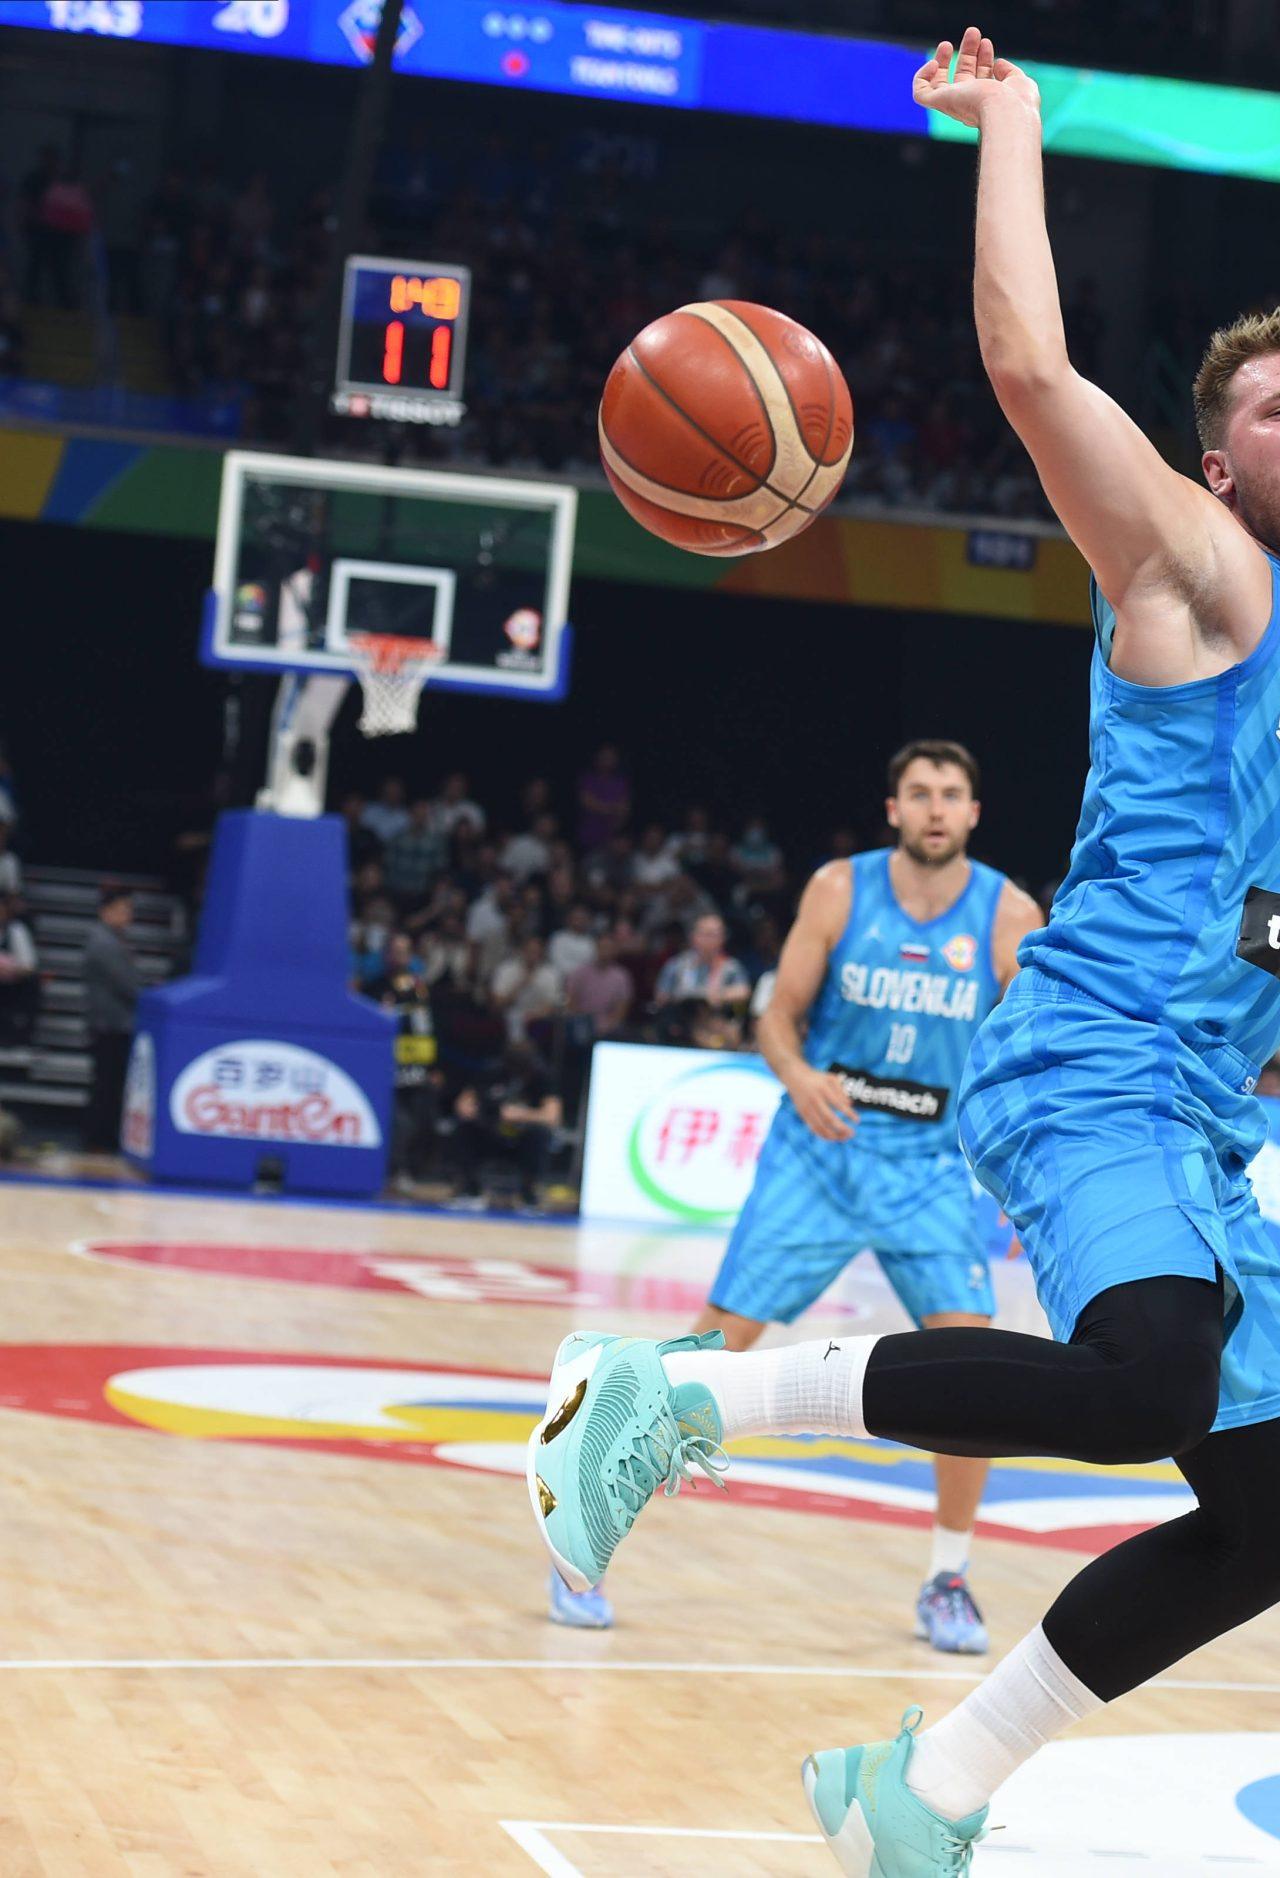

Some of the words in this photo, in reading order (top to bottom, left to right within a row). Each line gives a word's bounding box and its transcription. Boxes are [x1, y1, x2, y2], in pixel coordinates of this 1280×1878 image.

[382, 320, 452, 389] 11
[841, 963, 979, 1021] SLOVENIJA
[885, 1023, 917, 1064] 10
